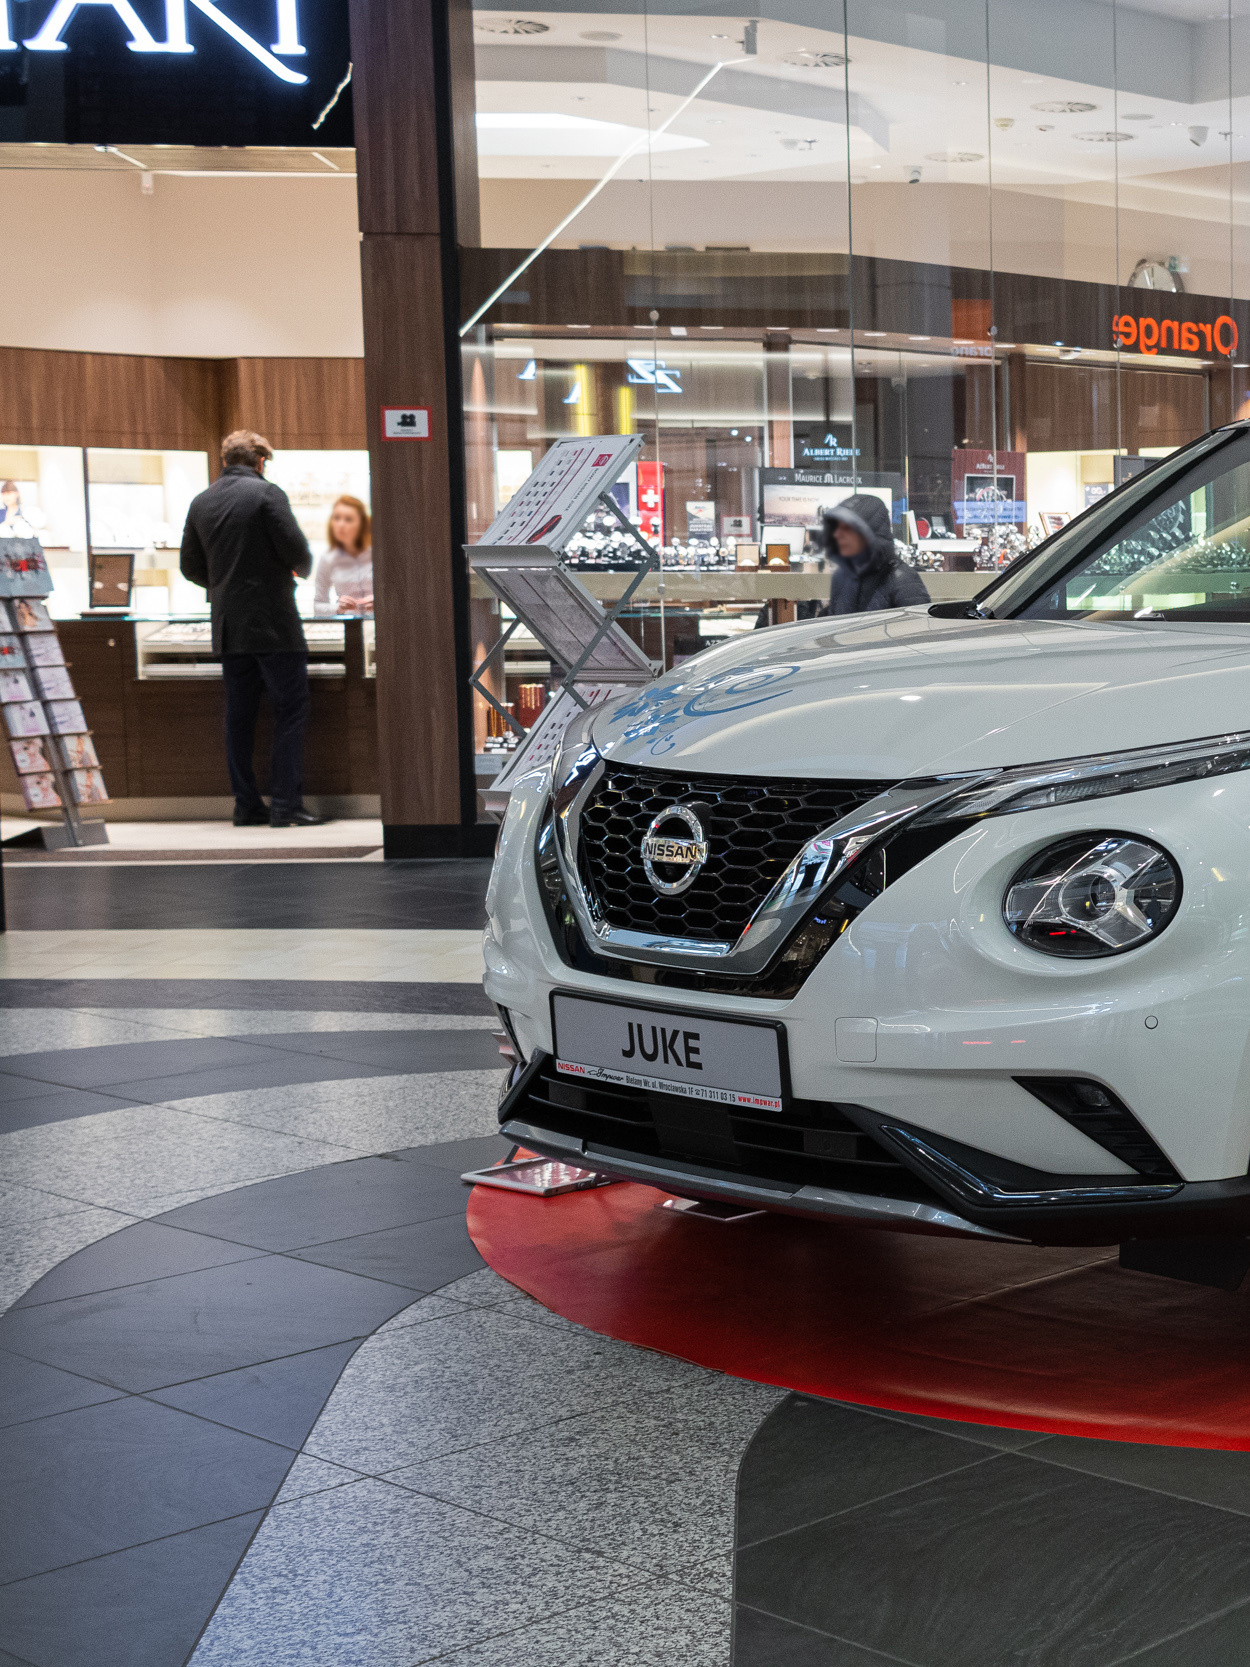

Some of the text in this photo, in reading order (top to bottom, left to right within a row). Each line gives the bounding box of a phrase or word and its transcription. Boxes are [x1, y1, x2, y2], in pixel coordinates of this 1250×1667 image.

[803, 447, 835, 456] ALBERT
[794, 472, 823, 483] MAURICE
[645, 842, 697, 860] NISSAN
[621, 1021, 704, 1071] JUKE
[557, 1062, 586, 1074] NISSAN
[701, 1088, 708, 1097] 71
[708, 1090, 719, 1100] 311
[720, 1092, 728, 1101] 03
[729, 1093, 736, 1102] 15
[737, 1095, 780, 1108] www.impwar.pl
